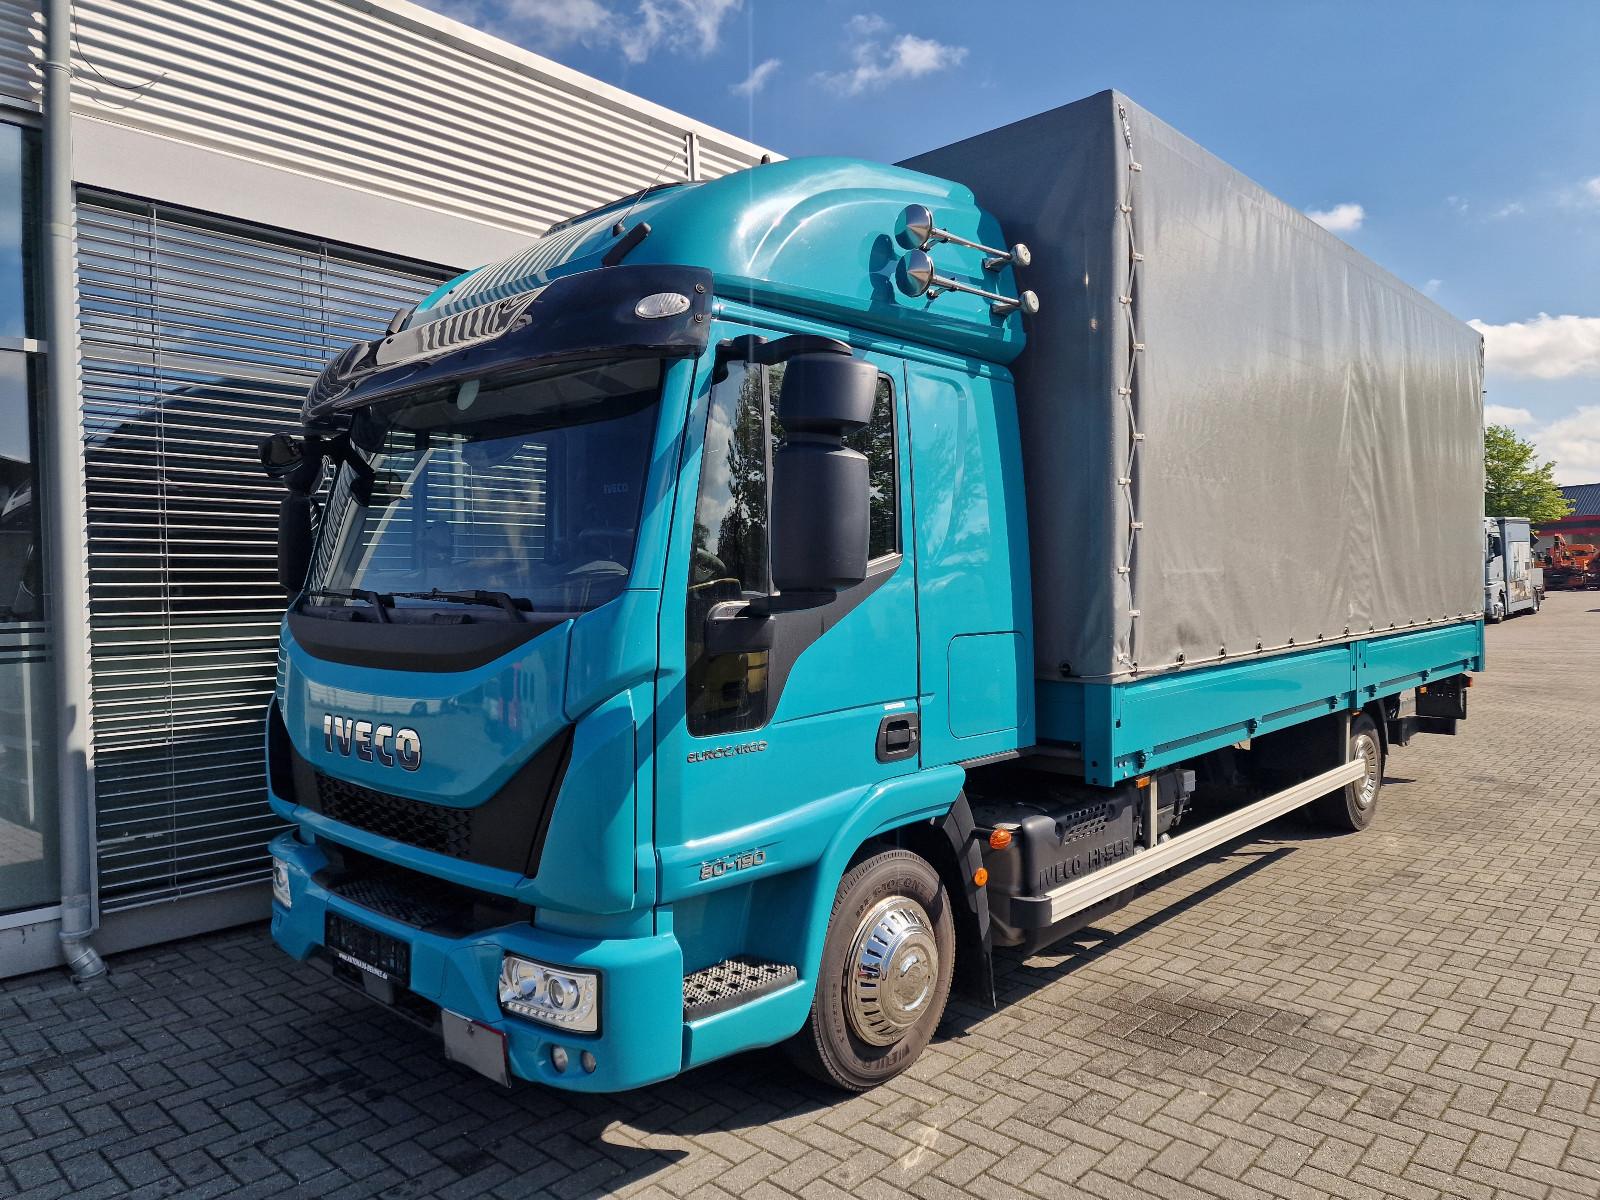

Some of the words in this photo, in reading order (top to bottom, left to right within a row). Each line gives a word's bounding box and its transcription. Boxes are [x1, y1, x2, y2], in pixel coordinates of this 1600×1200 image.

[323, 712, 423, 772] IVECO
[687, 740, 768, 763] EUROCARGO
[1039, 854, 1080, 891] IVECO
